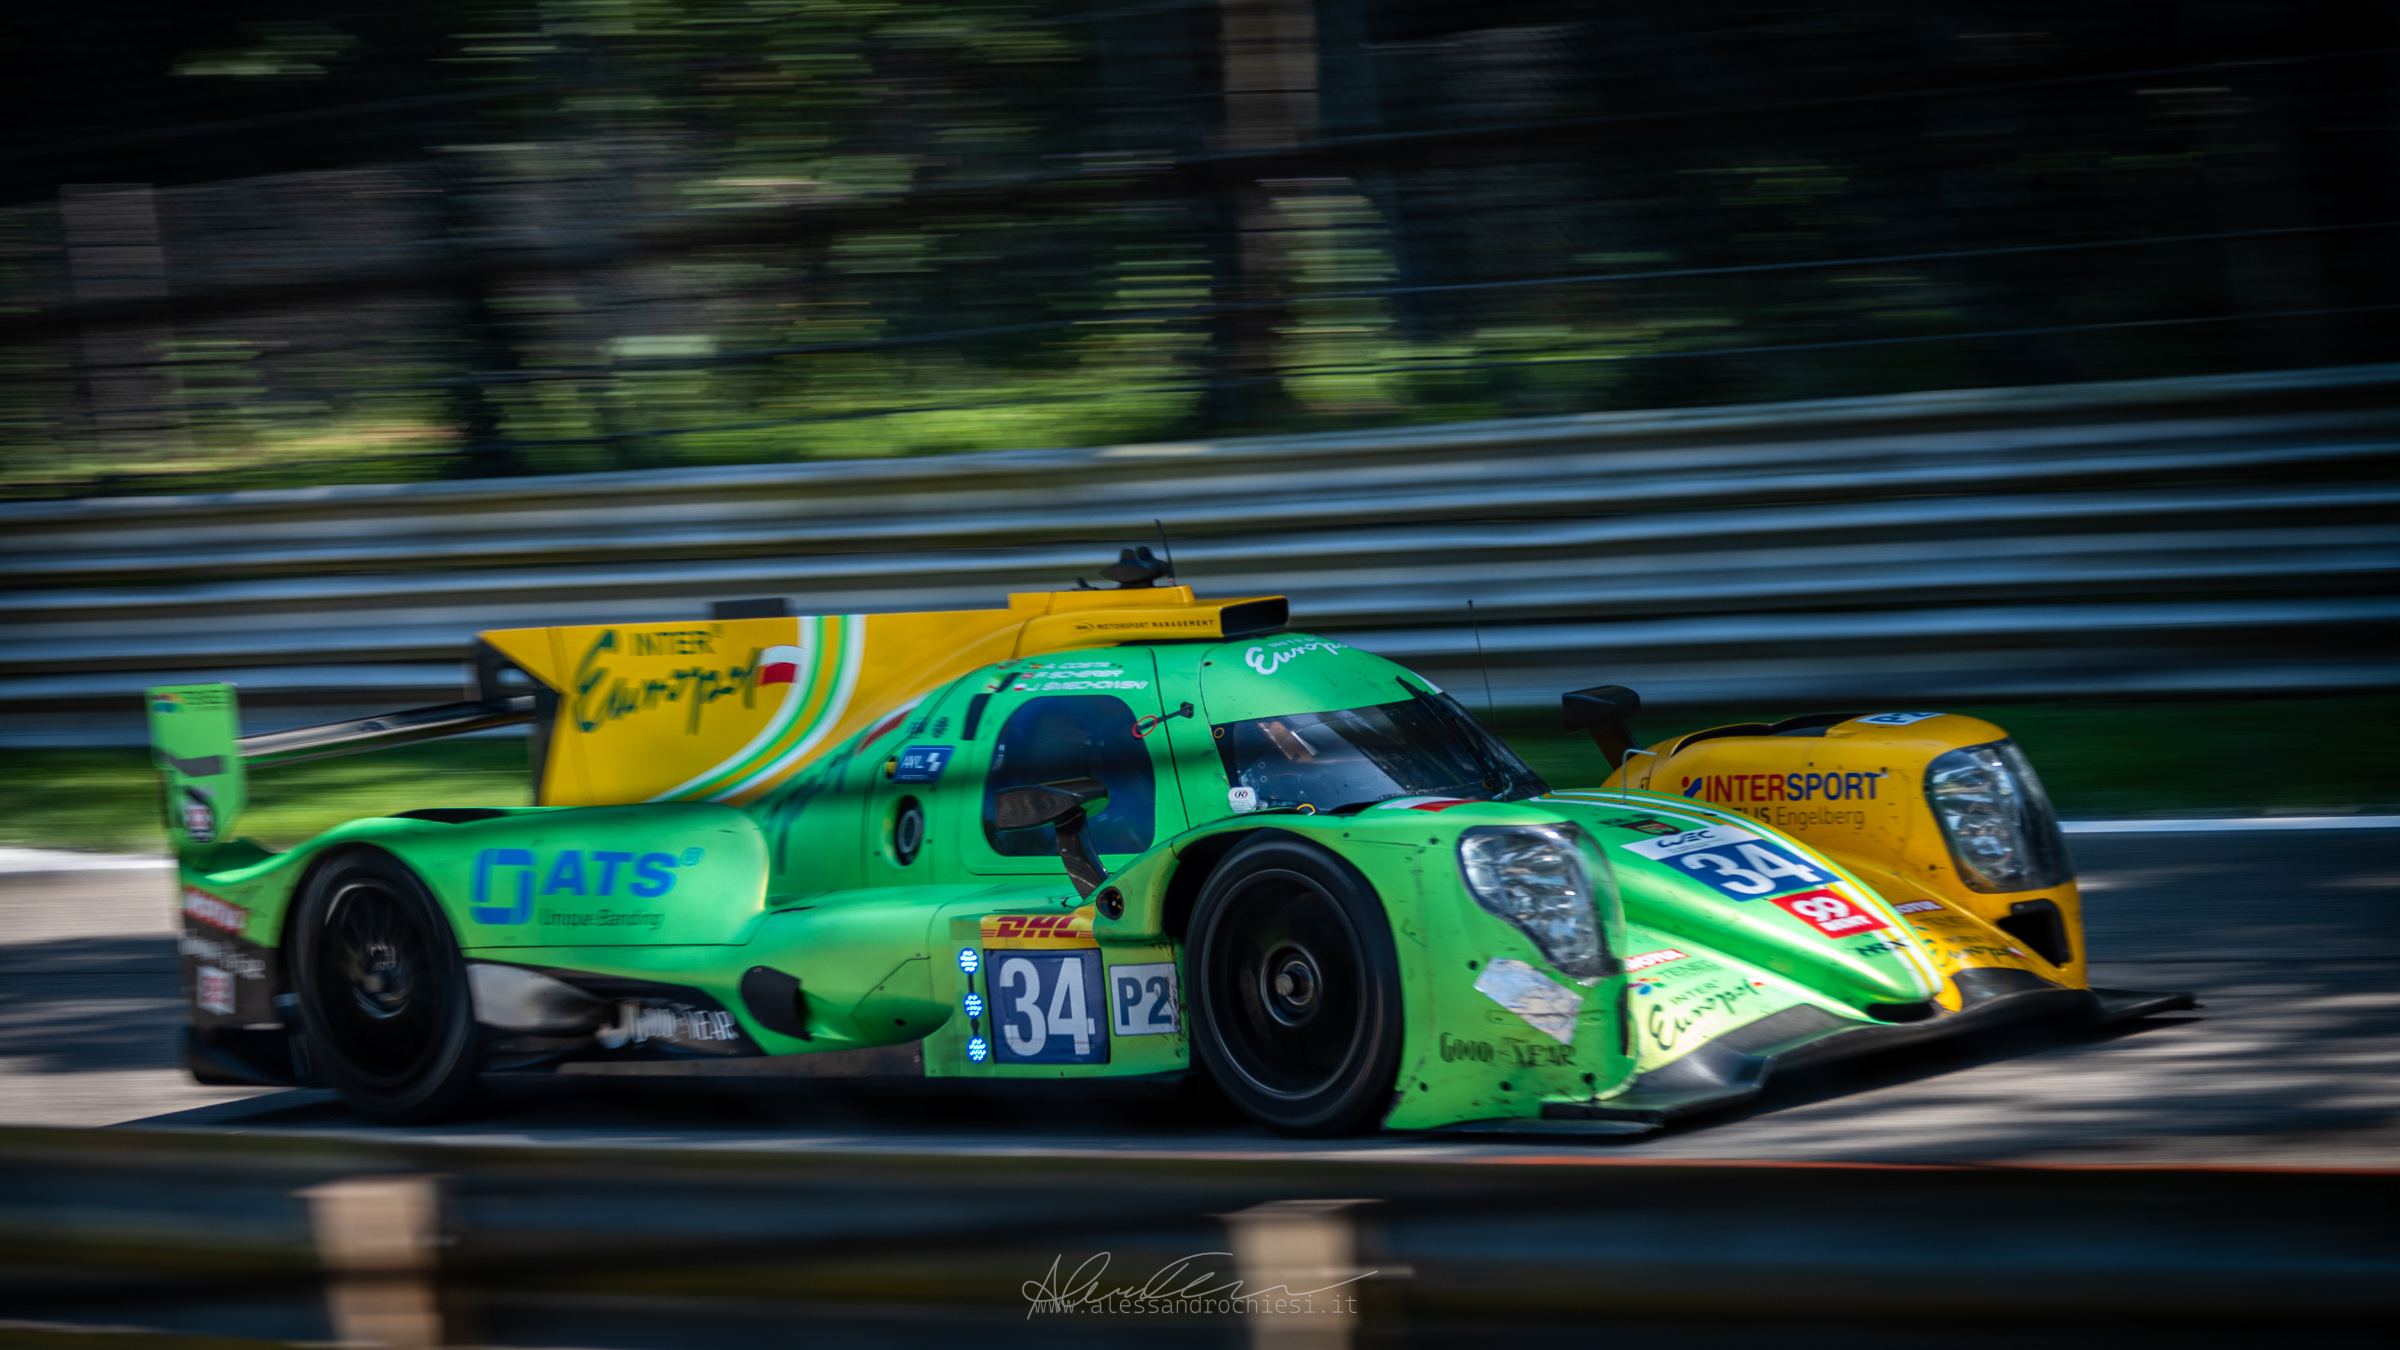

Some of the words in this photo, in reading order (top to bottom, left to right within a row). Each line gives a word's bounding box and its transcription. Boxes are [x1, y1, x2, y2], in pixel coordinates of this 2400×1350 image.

[1152, 619, 1214, 628] MANAGEMENT
[1706, 772, 1881, 802] INTERSPORT
[1776, 805, 1865, 831] Engelberg
[1680, 844, 1824, 896] 34
[1790, 896, 1851, 922] 99
[996, 916, 1078, 938] DHL
[999, 957, 1096, 1057] 34
[1117, 975, 1173, 1027] P2
